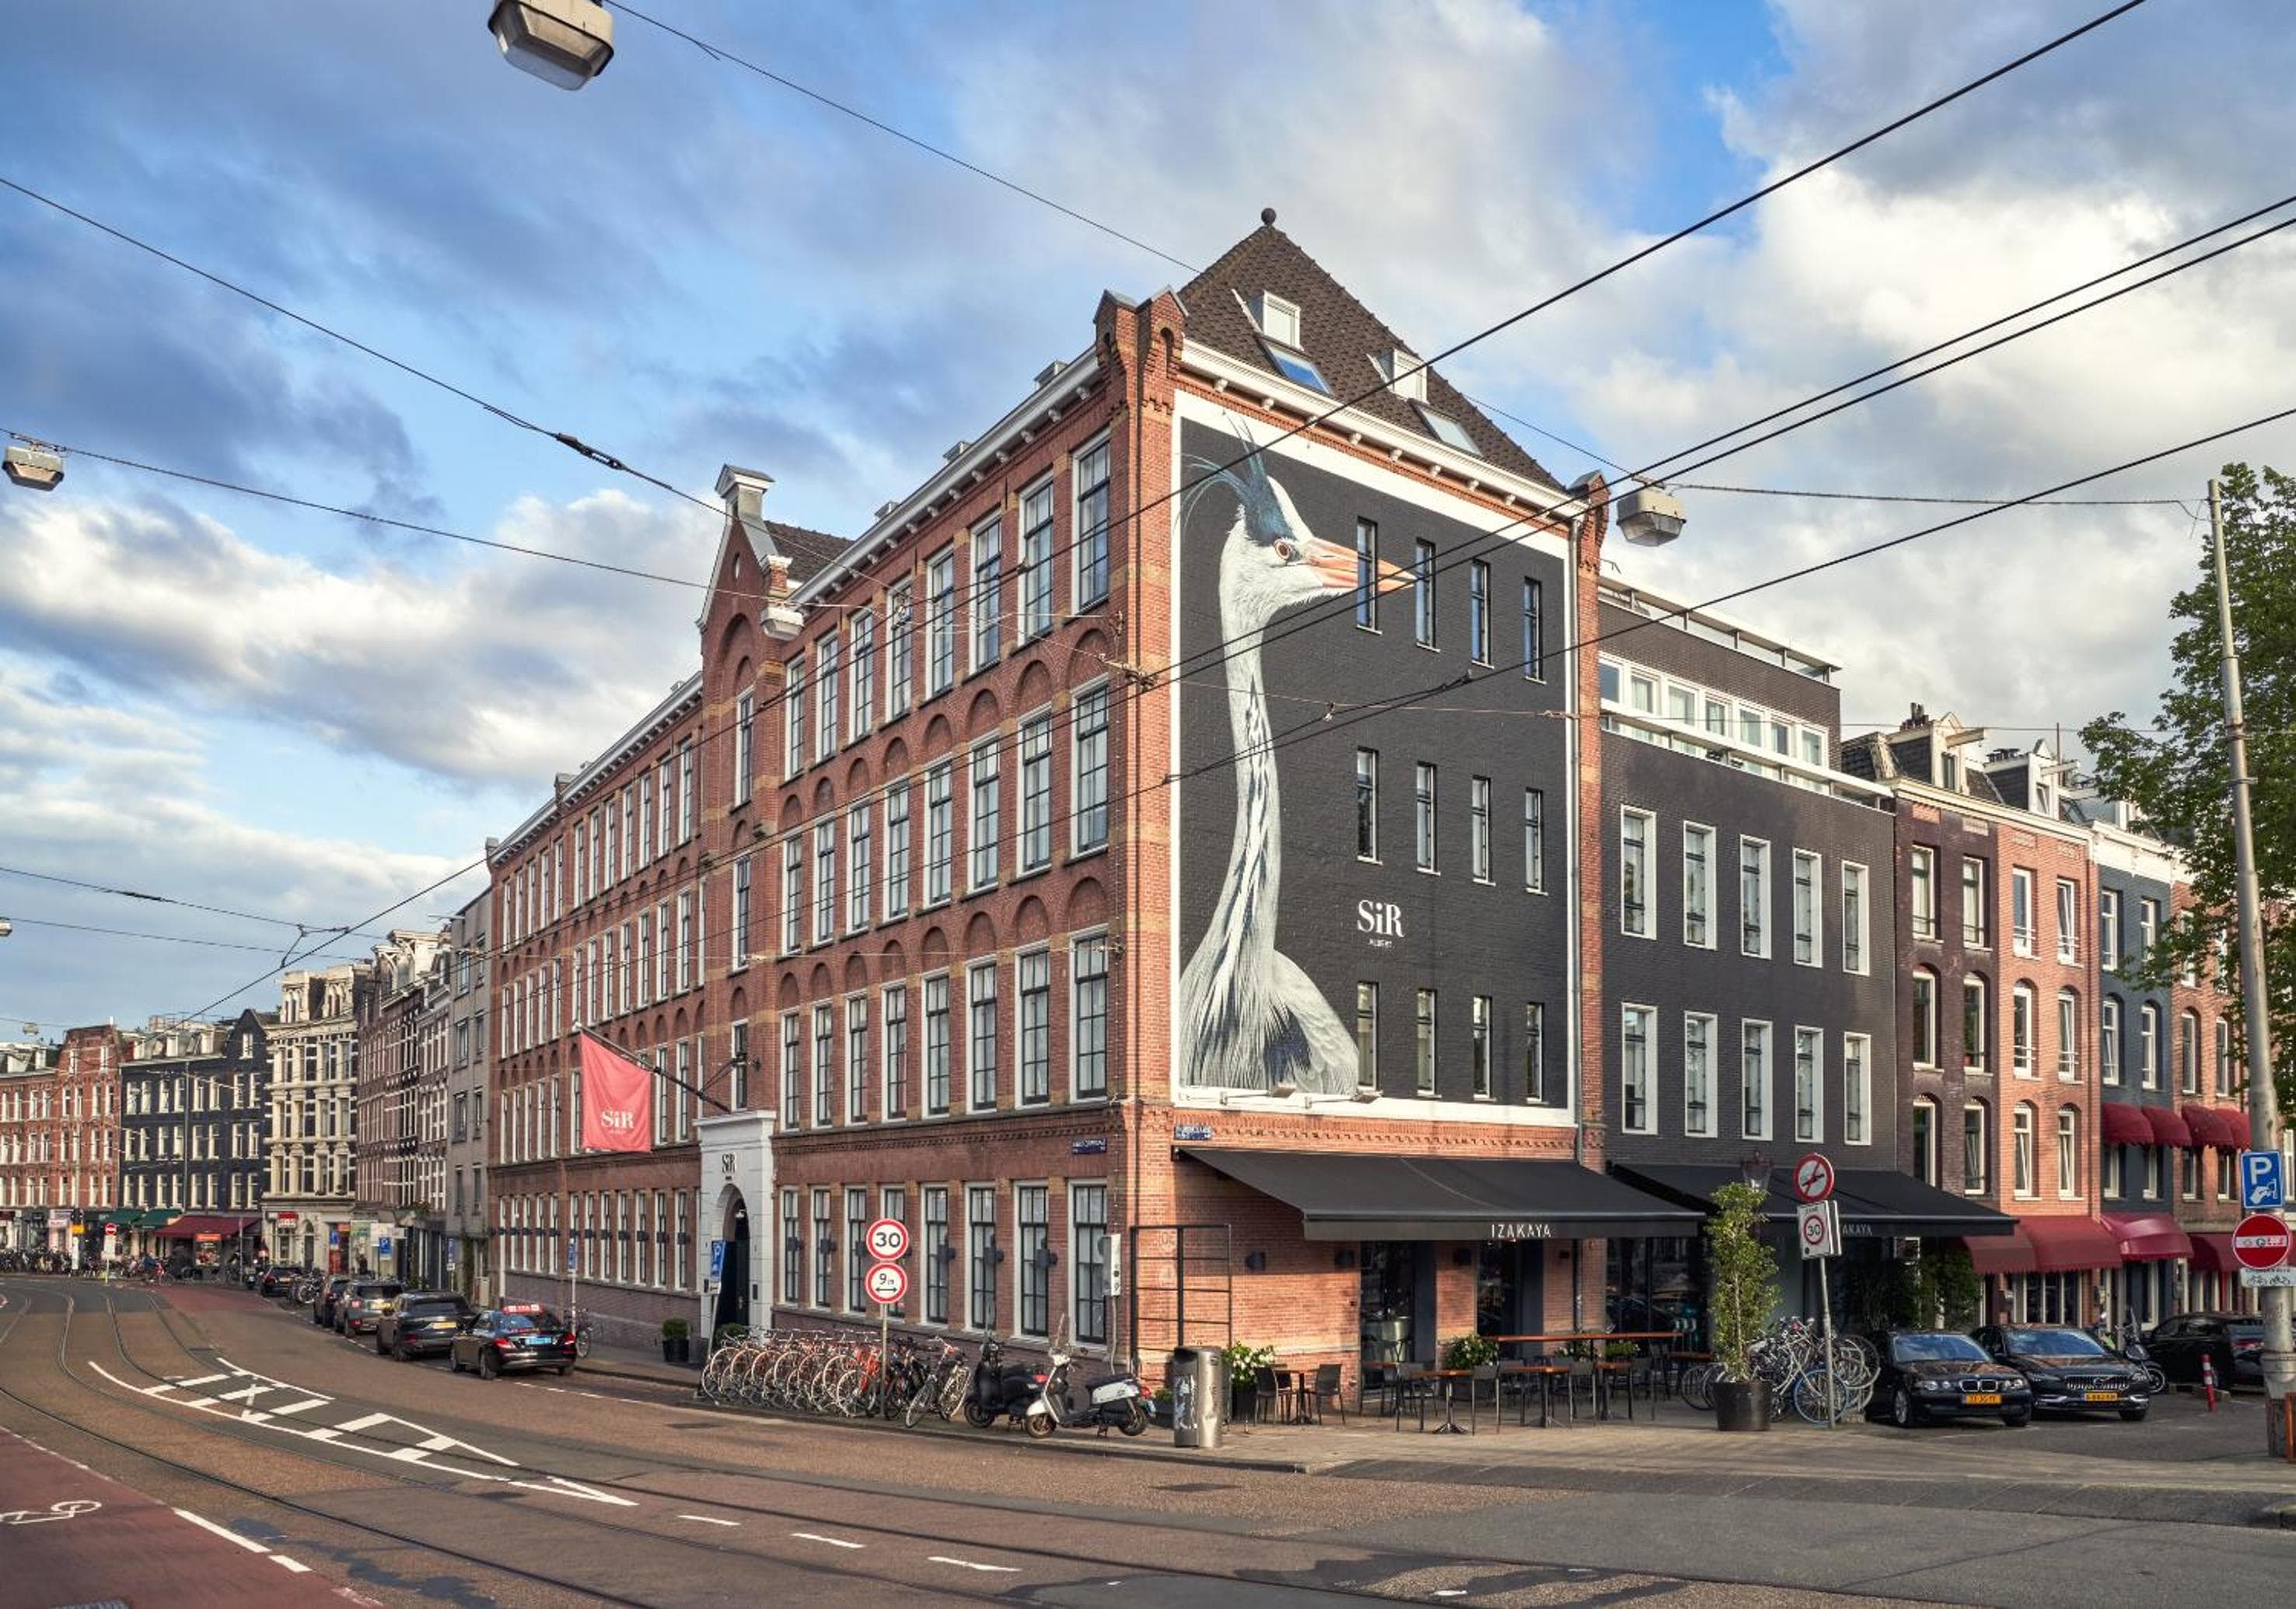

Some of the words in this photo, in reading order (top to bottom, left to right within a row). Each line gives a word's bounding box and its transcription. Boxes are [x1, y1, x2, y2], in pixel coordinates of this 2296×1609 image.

[2249, 1156, 2273, 1185] P
[1491, 1223, 1551, 1238] IZAKAYA
[1807, 1224, 1821, 1236] 30
[1842, 1224, 1873, 1236] AKAYA
[875, 1232, 900, 1248] 30
[714, 1244, 722, 1262] P
